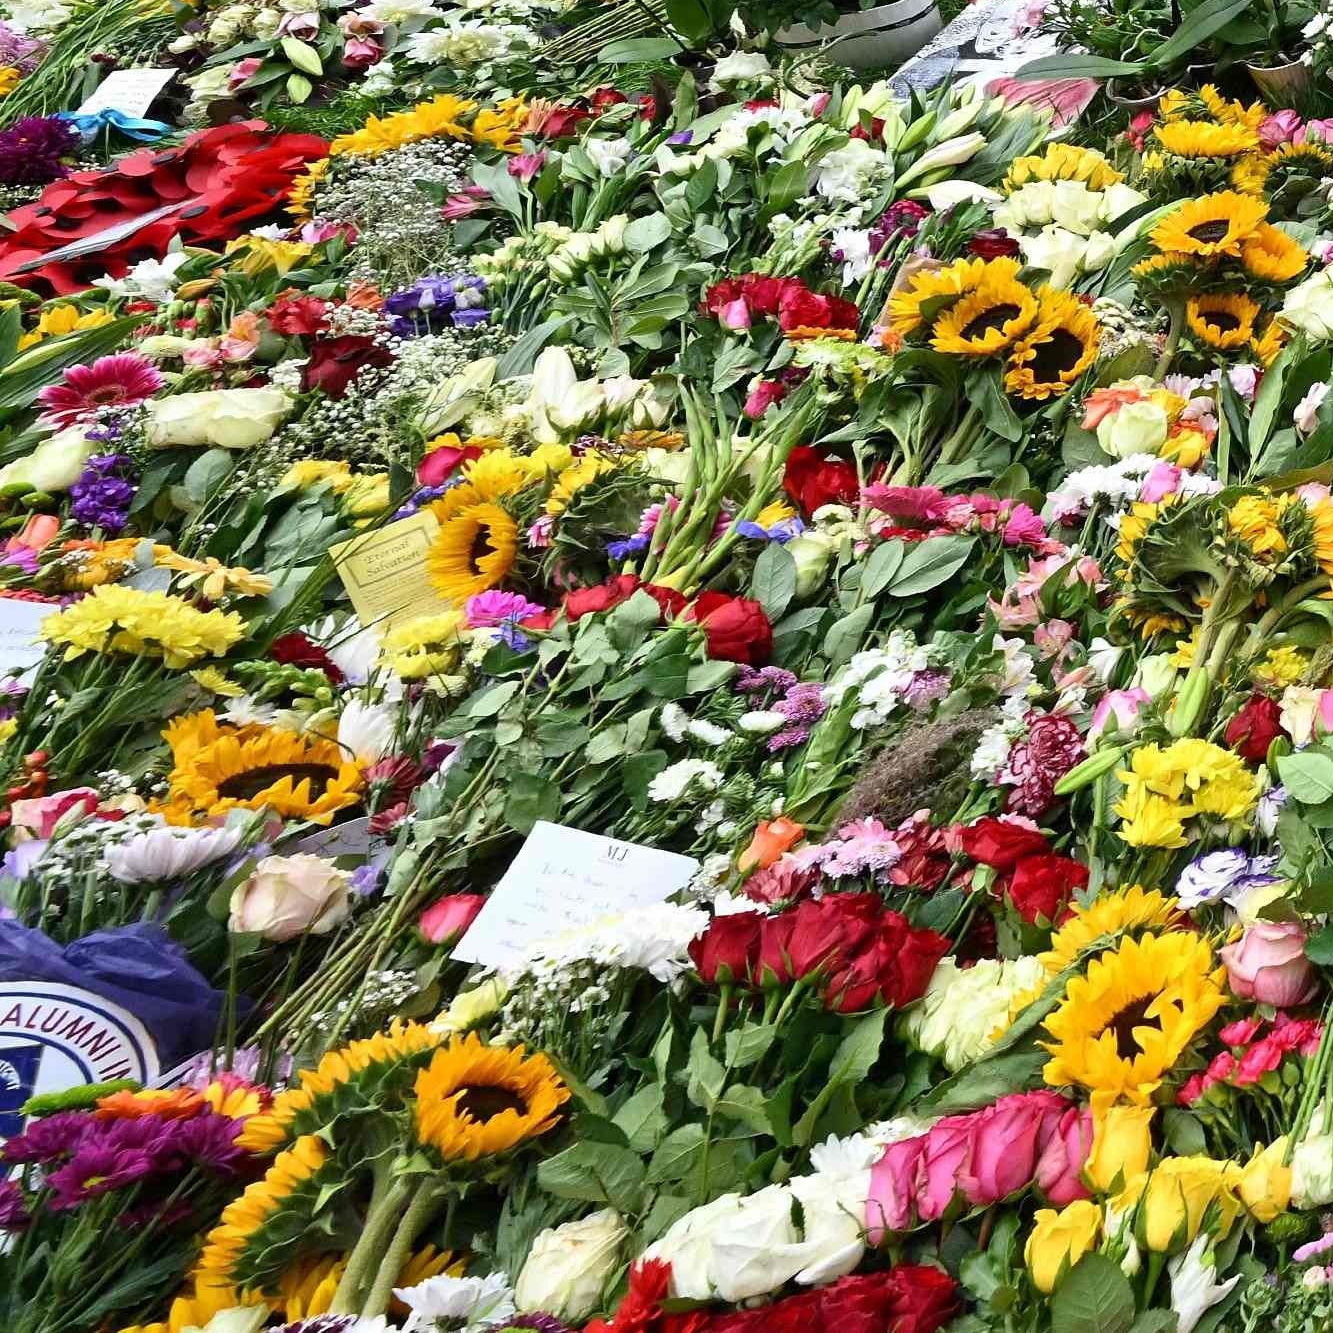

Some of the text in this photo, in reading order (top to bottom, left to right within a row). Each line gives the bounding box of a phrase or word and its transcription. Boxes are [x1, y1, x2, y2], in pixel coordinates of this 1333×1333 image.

[364, 538, 408, 565] Eternal
[606, 845, 629, 861] MJ
[1, 1003, 121, 1062] ALUMNI
